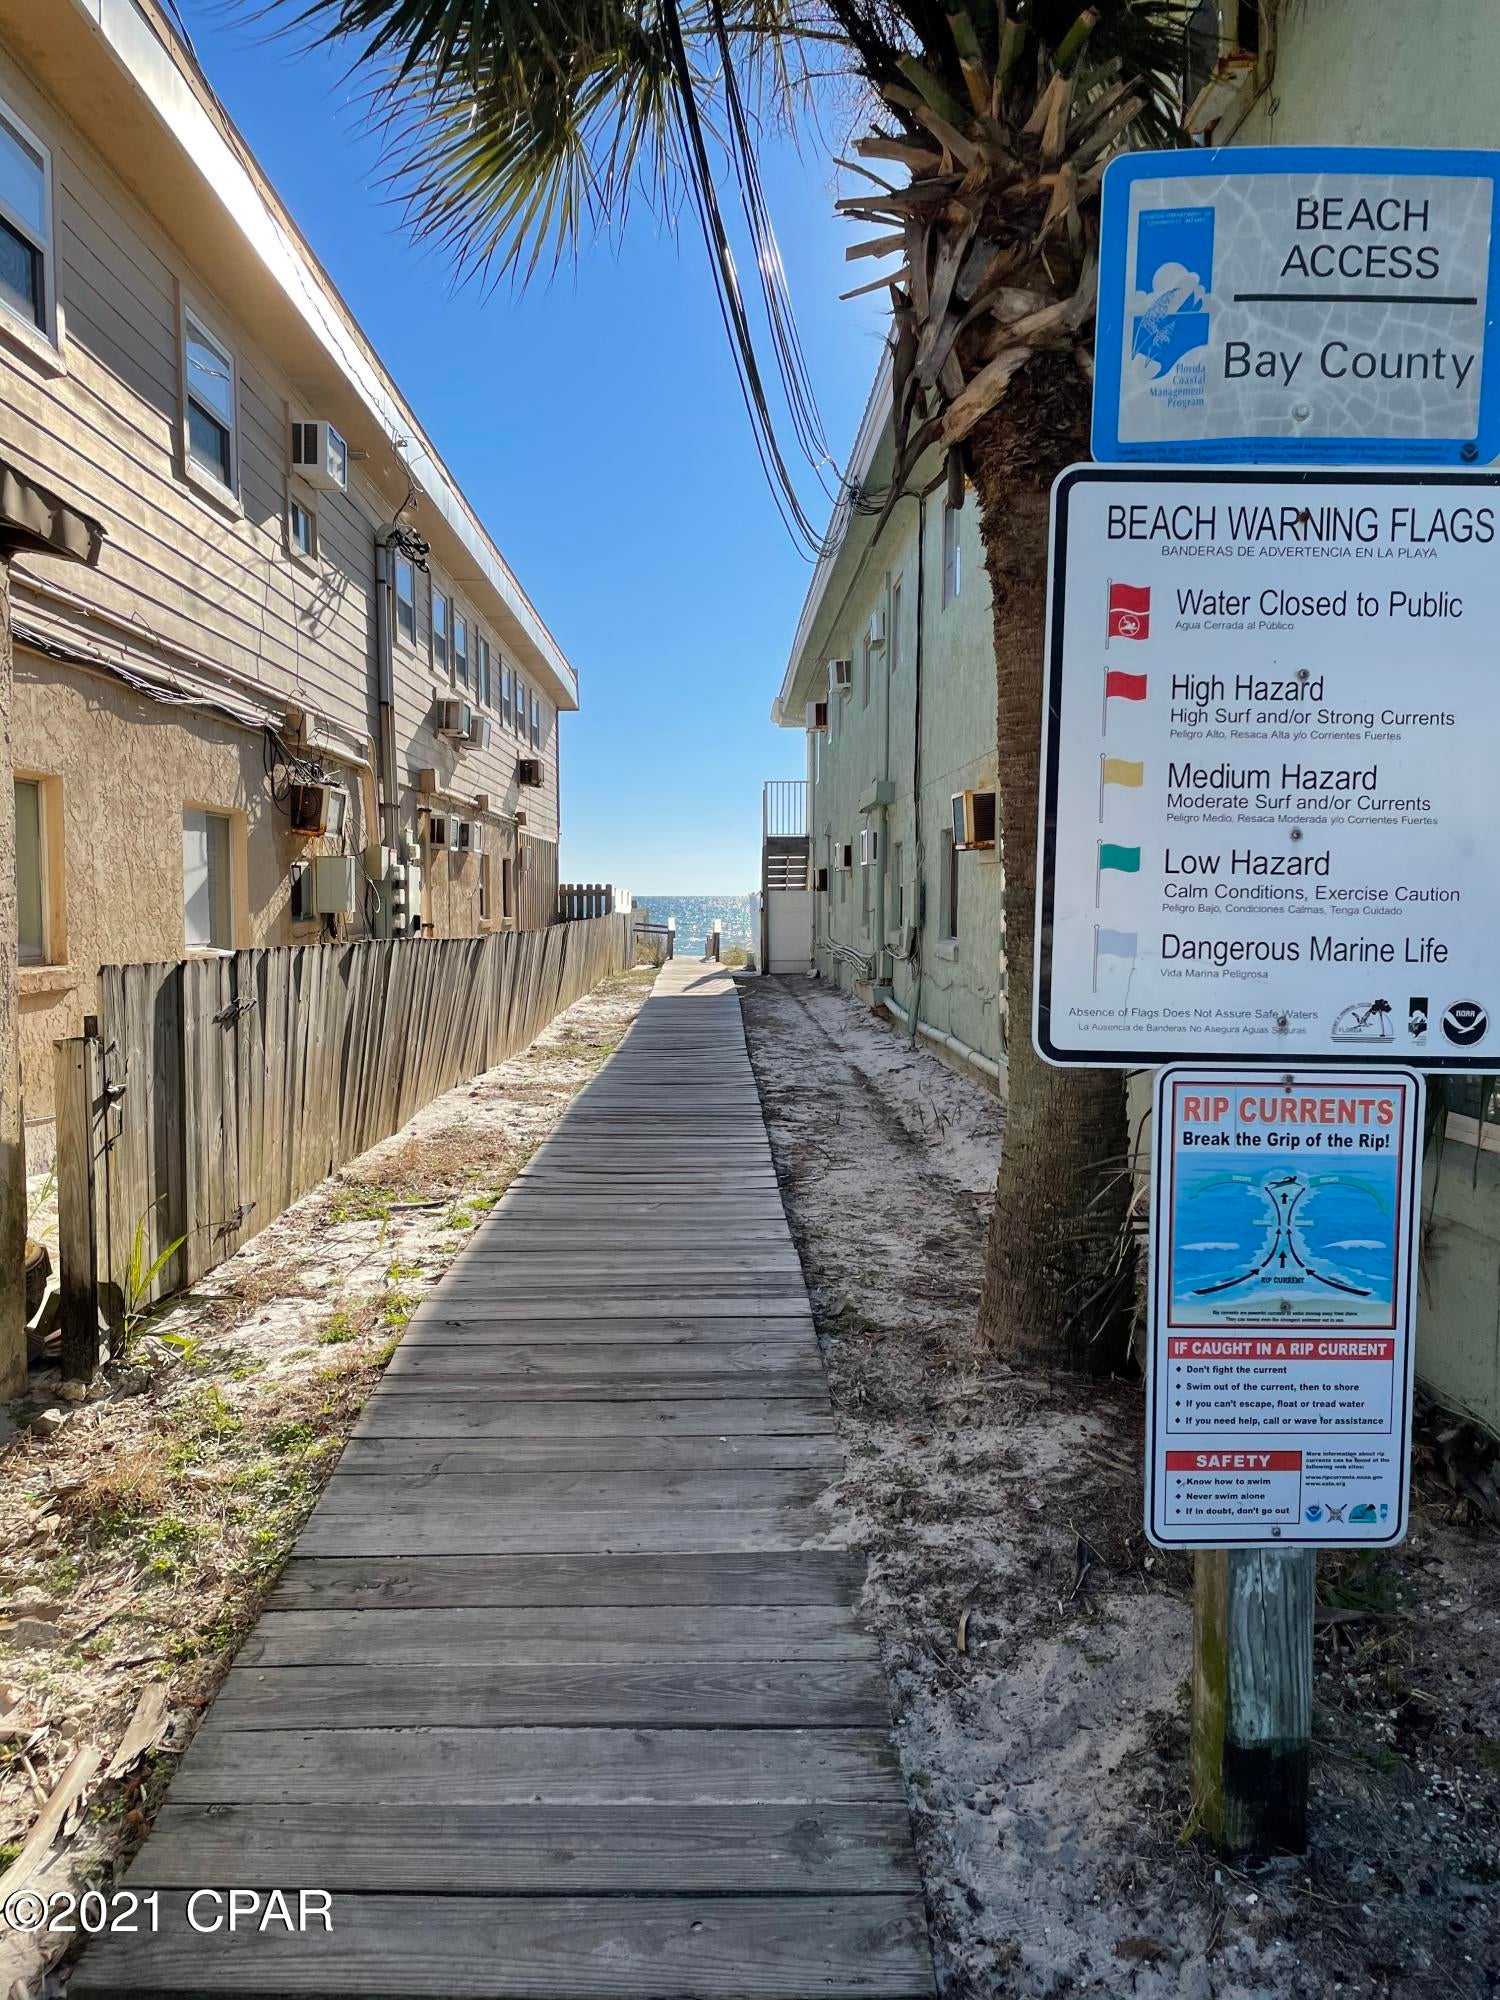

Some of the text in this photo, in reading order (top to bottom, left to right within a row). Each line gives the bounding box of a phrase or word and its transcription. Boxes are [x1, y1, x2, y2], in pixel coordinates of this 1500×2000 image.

[1296, 197, 1429, 232] BEACH
[1280, 244, 1439, 279] ACCESS
[1223, 341, 1474, 389] Bay County
[1107, 504, 1494, 543] BEACH WARNING FLAGS
[1161, 545, 1437, 558] BANDERAS DE ADVERTENCIA EN LA PLAYA
[1176, 588, 1462, 617] Water Closed to Public
[1174, 620, 1201, 631] Agua
[1203, 620, 1244, 629] Cerrada
[1246, 620, 1255, 629] al
[1171, 674, 1323, 706] High Hazard
[1170, 707, 1455, 727] High Surf and/or Strong Currents
[1169, 729, 1203, 740] Peligro
[1230, 729, 1268, 739] Resaca
[1270, 729, 1290, 739] Alta
[1309, 730, 1361, 740] Corrientes
[1364, 730, 1401, 740] Fuertes
[1168, 762, 1377, 790] Medium Hazard
[1167, 793, 1430, 811] Moderate Surf and/or Currents
[1166, 812, 1200, 824] Peligro
[1236, 813, 1274, 823] Resaca
[1277, 814, 1327, 823] Moderada
[1347, 815, 1398, 824] Corrientes
[1401, 815, 1438, 825] Fuertes
[1164, 848, 1330, 876] Low Hazard
[1164, 883, 1460, 901] Calm Conditions, Exercise Caution
[1161, 903, 1195, 914] Peligro
[1224, 903, 1285, 913] Condiciones
[1330, 905, 1359, 916] Tenga
[1362, 905, 1403, 915] Cuidado
[1162, 933, 1448, 966] Dangerous Marine Life
[1160, 968, 1268, 980] Vida Marina Peligrosa
[1068, 1007, 1319, 1020] Absence of Flags Does Not Assure Safe Waters
[1184, 1096, 1393, 1124] RIP CURRENTS
[1183, 1131, 1389, 1151] Break the Grip of the Rip!
[1260, 1276, 1304, 1284] RIP CURRENT
[1174, 1341, 1387, 1355] IF CAUGHT IN A RIP CURRENT
[1186, 1365, 1287, 1375] Don't fight the current
[1186, 1382, 1211, 1390] Swim
[1230, 1382, 1240, 1390] of
[1299, 1383, 1319, 1391] then
[1322, 1383, 1331, 1391] to
[1333, 1383, 1359, 1391] shore
[1186, 1399, 1192, 1407] If
[1195, 1401, 1211, 1409] you
[1213, 1399, 1236, 1407] can't
[1277, 1399, 1297, 1407] float
[1312, 1399, 1336, 1408] tread
[1185, 1416, 1192, 1424] If
[1195, 1418, 1211, 1426] you
[1213, 1416, 1236, 1424] need
[1262, 1416, 1279, 1424] call
[1334, 1416, 1383, 1424] assistance
[1196, 1454, 1270, 1467] SAFETY
[1214, 1477, 1233, 1485] how
[1247, 1477, 1270, 1485] swim
[1186, 1492, 1212, 1500] Never
[1236, 1506, 1259, 1514] don't
